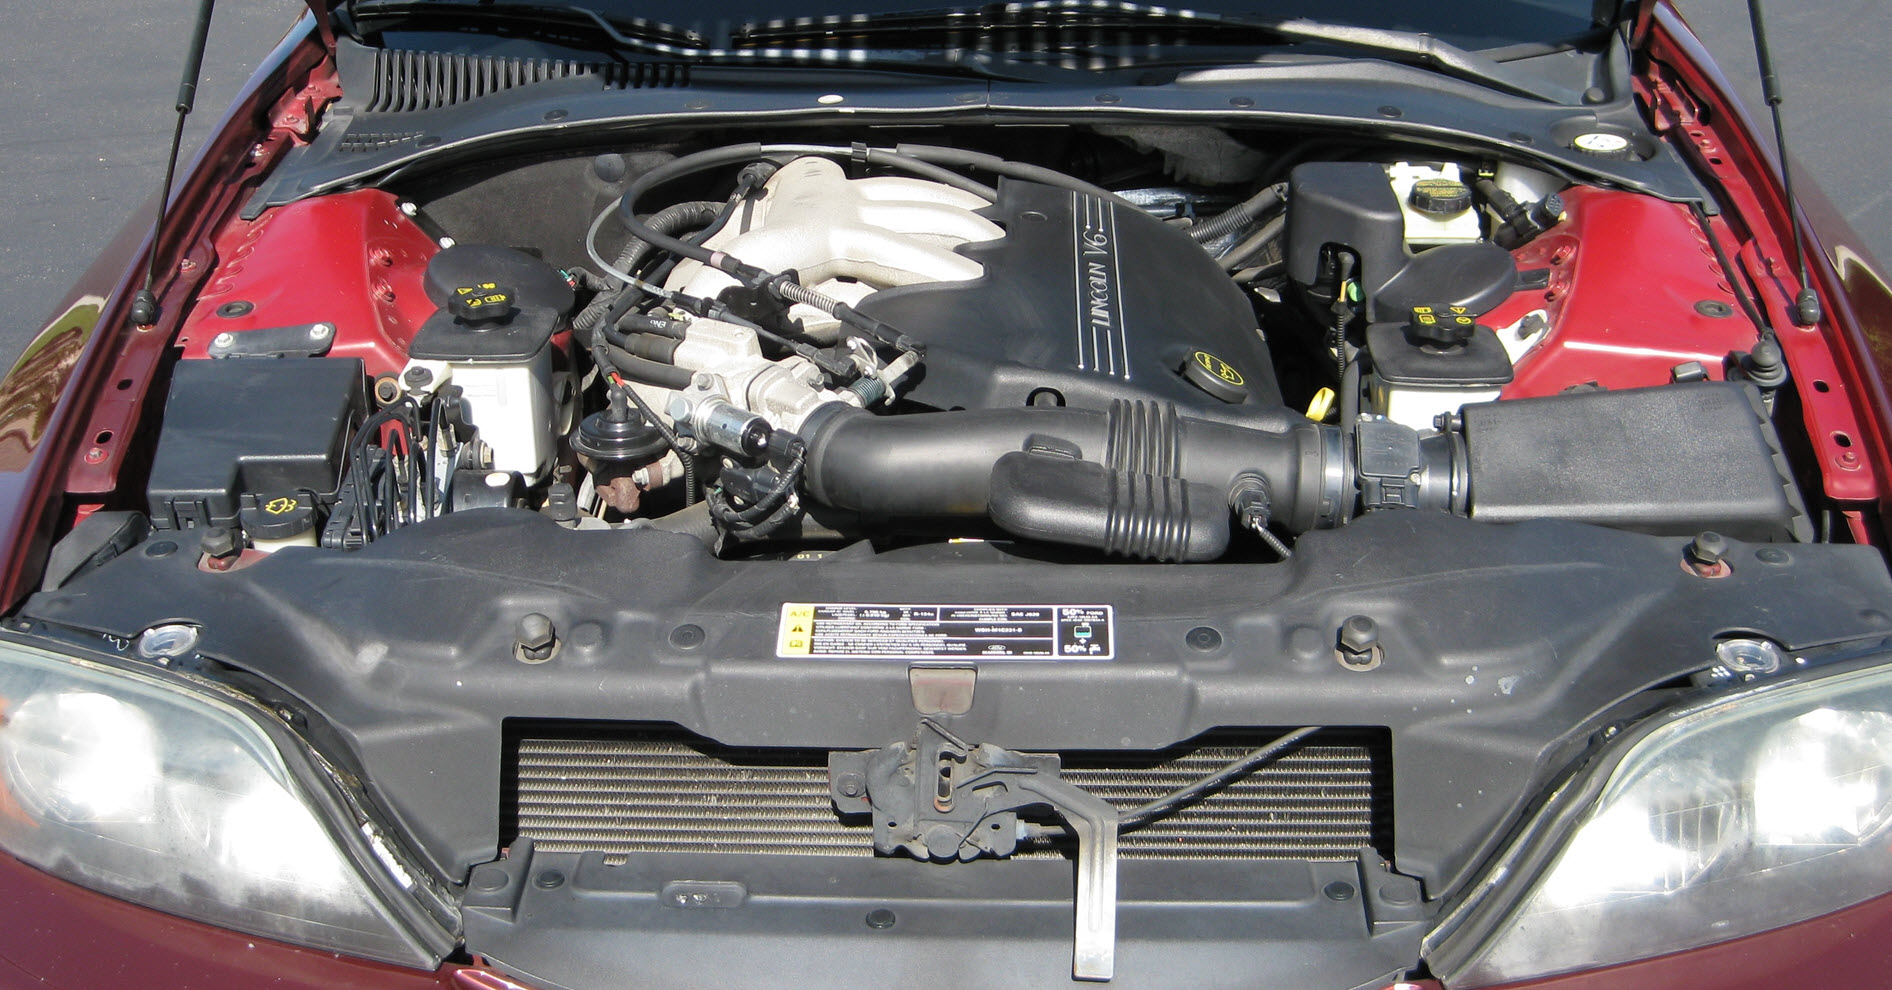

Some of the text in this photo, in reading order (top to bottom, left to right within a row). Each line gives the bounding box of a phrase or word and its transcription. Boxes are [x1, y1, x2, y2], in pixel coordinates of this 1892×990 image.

[1083, 230, 1111, 327] LINCOLN V6
[1063, 644, 1087, 653] 50%
